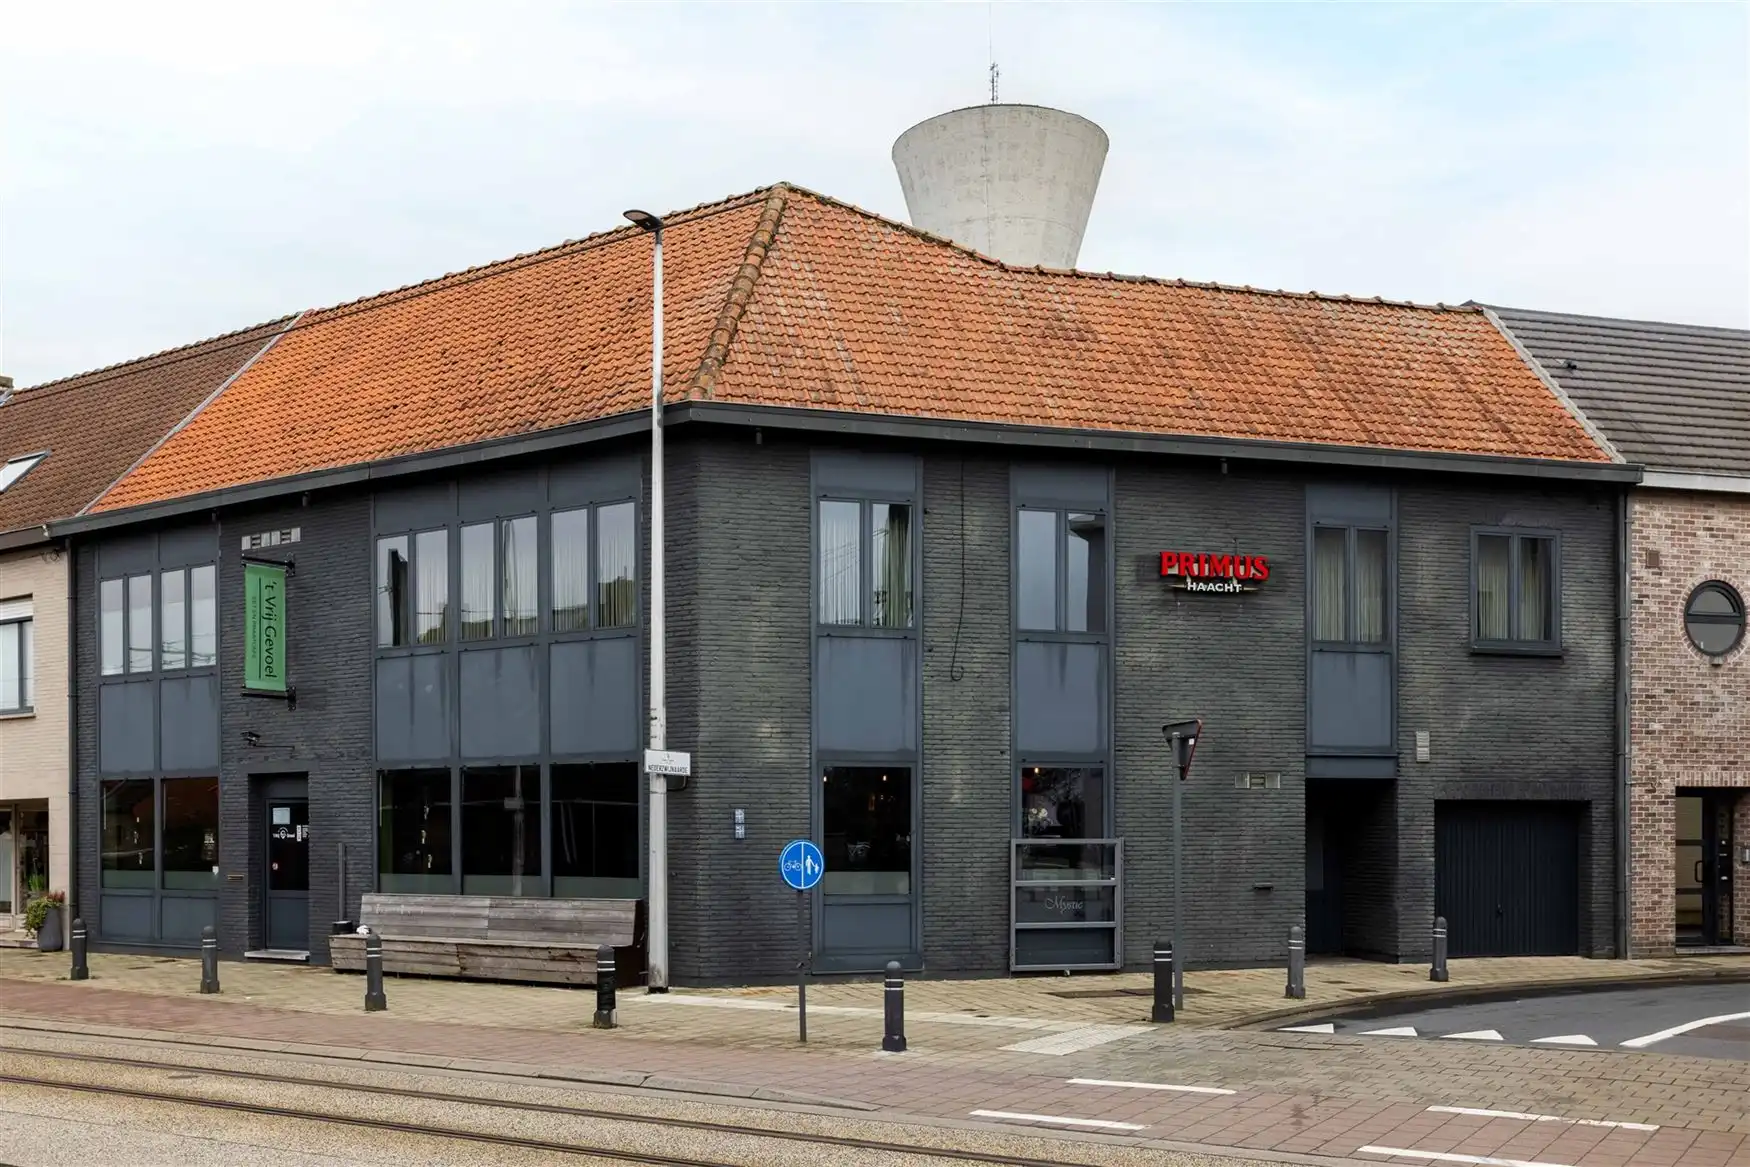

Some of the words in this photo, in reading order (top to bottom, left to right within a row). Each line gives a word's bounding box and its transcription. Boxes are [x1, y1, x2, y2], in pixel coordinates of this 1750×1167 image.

[1160, 551, 1270, 581] PRIMUS
[1187, 582, 1242, 593] HAACHT
[262, 596, 277, 621] Vrij
[265, 626, 277, 678] Gevoel
[1045, 896, 1084, 914] Mystic
